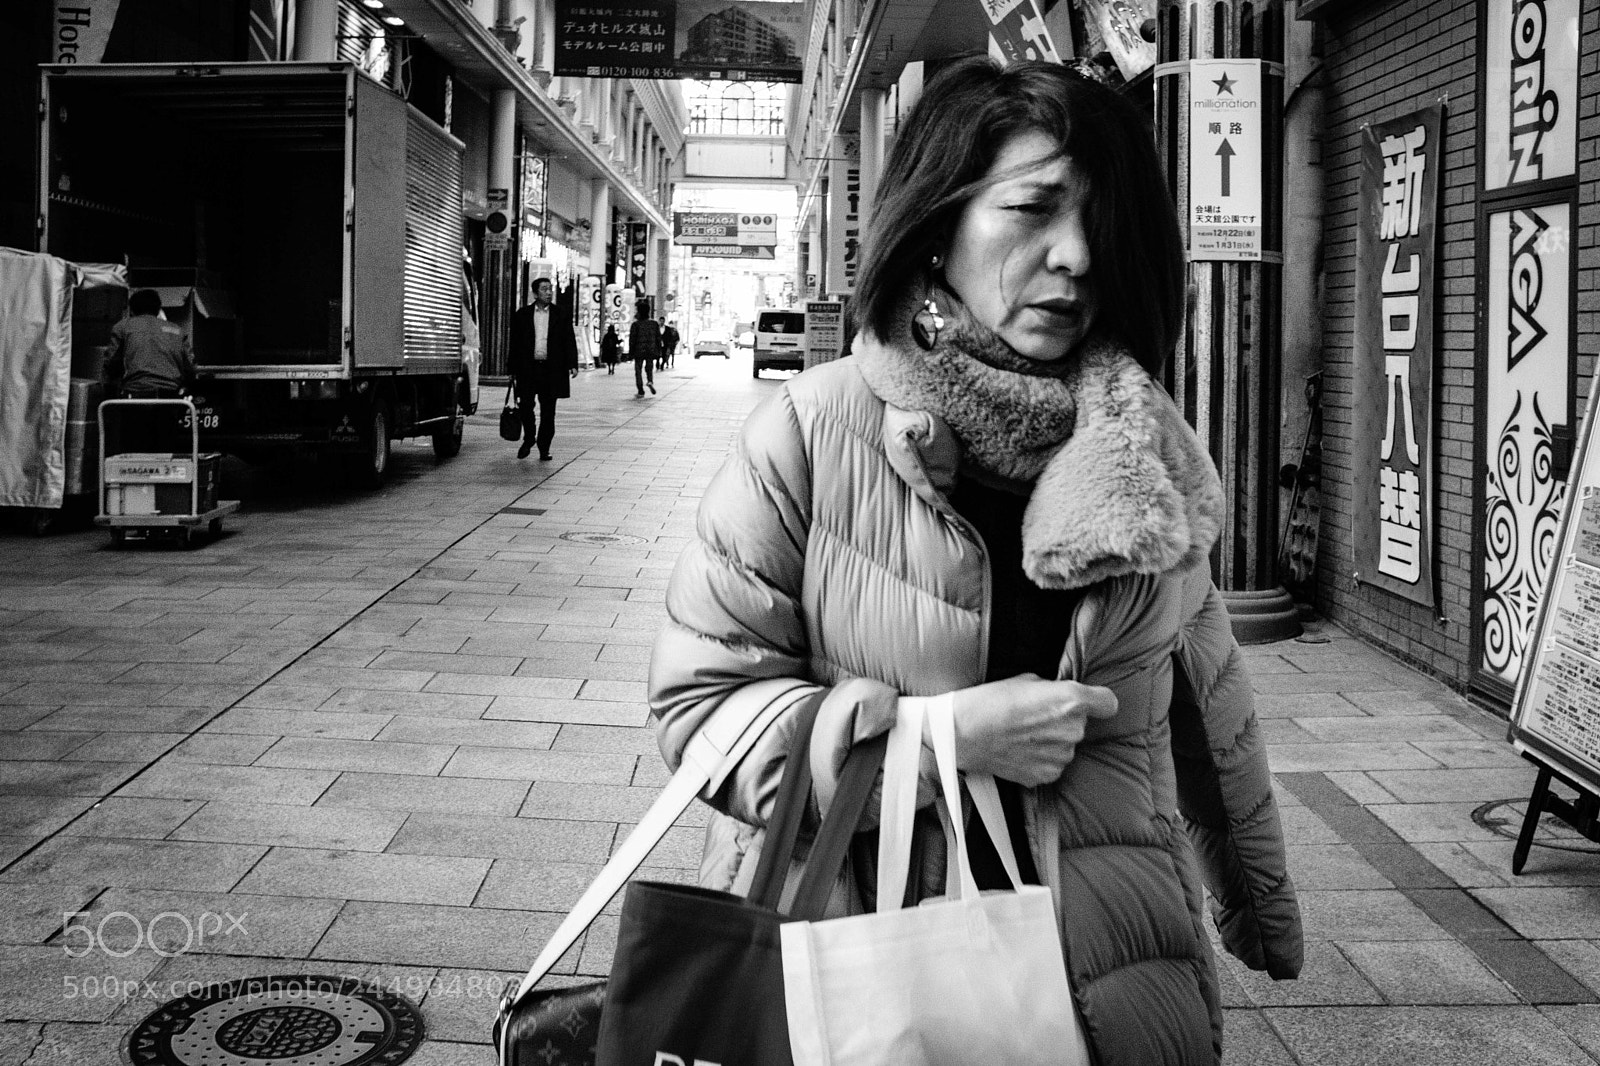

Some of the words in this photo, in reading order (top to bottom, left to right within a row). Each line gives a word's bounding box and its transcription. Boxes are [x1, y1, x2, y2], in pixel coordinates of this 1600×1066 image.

[562, 40, 665, 53] モデルルーム公開中
[1195, 205, 1221, 213] 会場は
[1195, 215, 1256, 223] 天文館公園です
